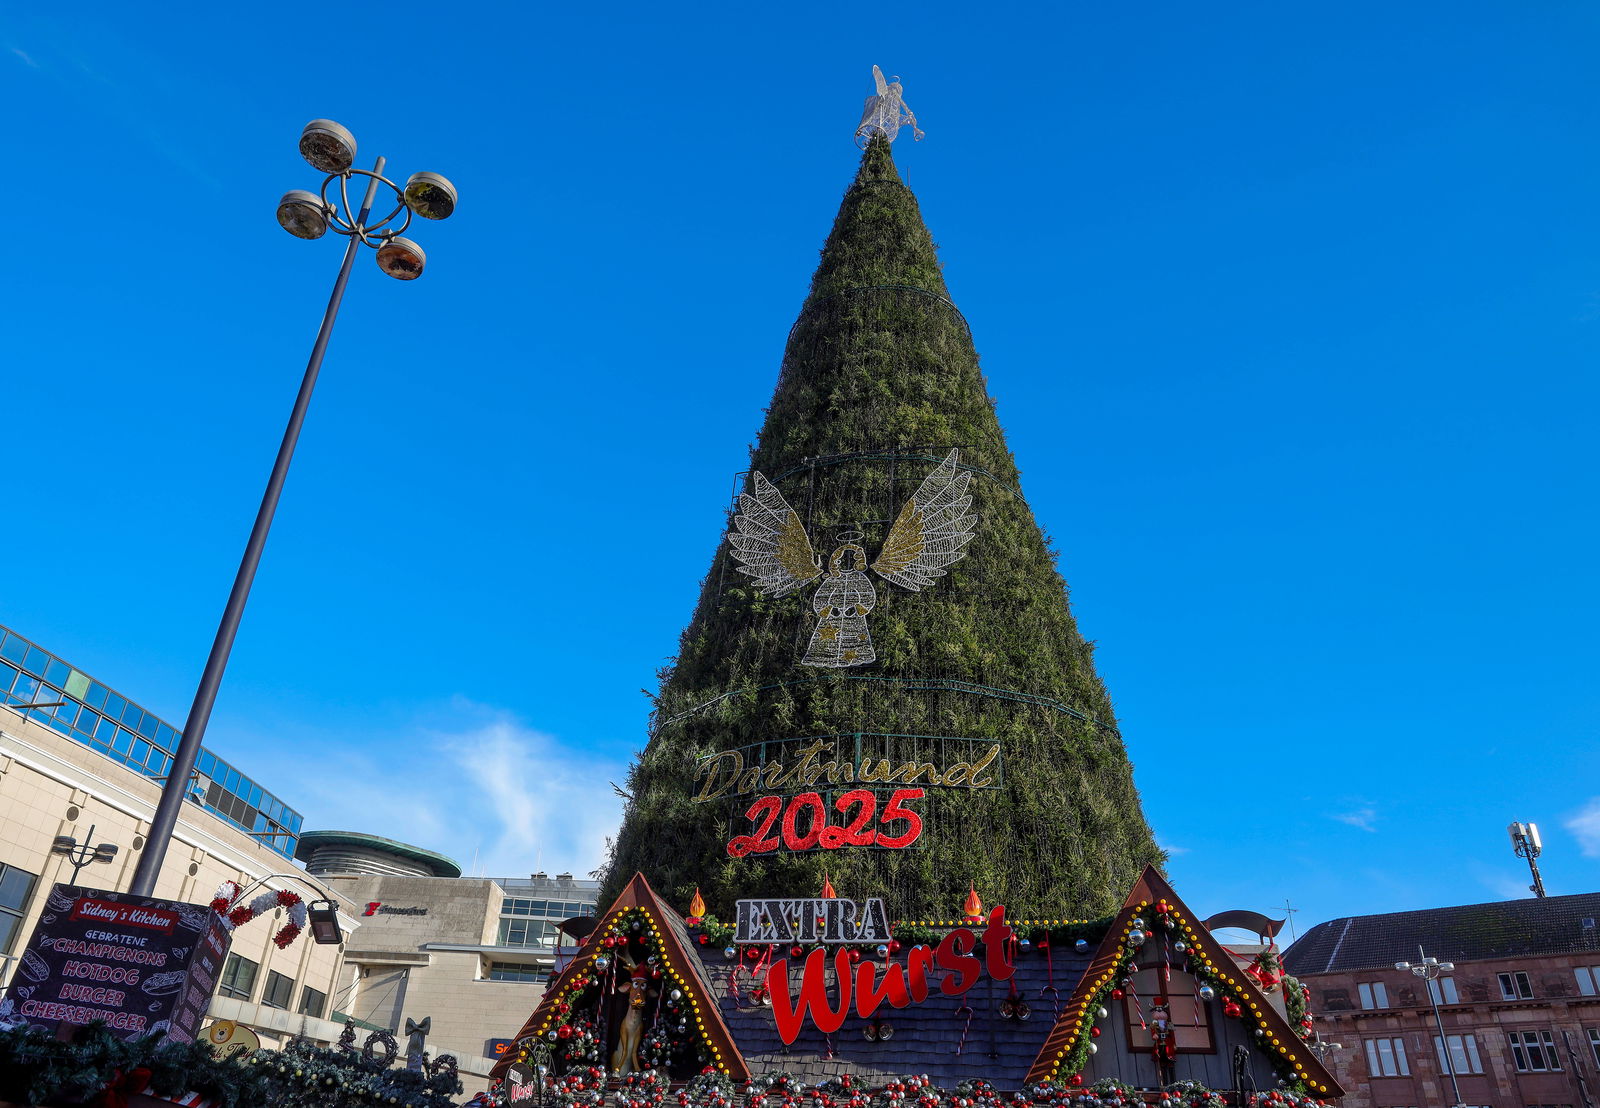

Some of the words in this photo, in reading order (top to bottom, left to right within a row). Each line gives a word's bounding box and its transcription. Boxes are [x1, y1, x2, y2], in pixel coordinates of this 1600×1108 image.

[690, 738, 1001, 803] Dortmund
[726, 788, 925, 858] 2025
[129, 909, 171, 927] Kitchen
[733, 898, 893, 944] EXTRA
[53, 938, 167, 967] CHAMPIGNONS
[85, 929, 148, 947] GEBRATENE
[62, 960, 140, 985] HOTDOG
[768, 905, 1017, 1046] Wurst
[58, 983, 126, 1007] BURGER
